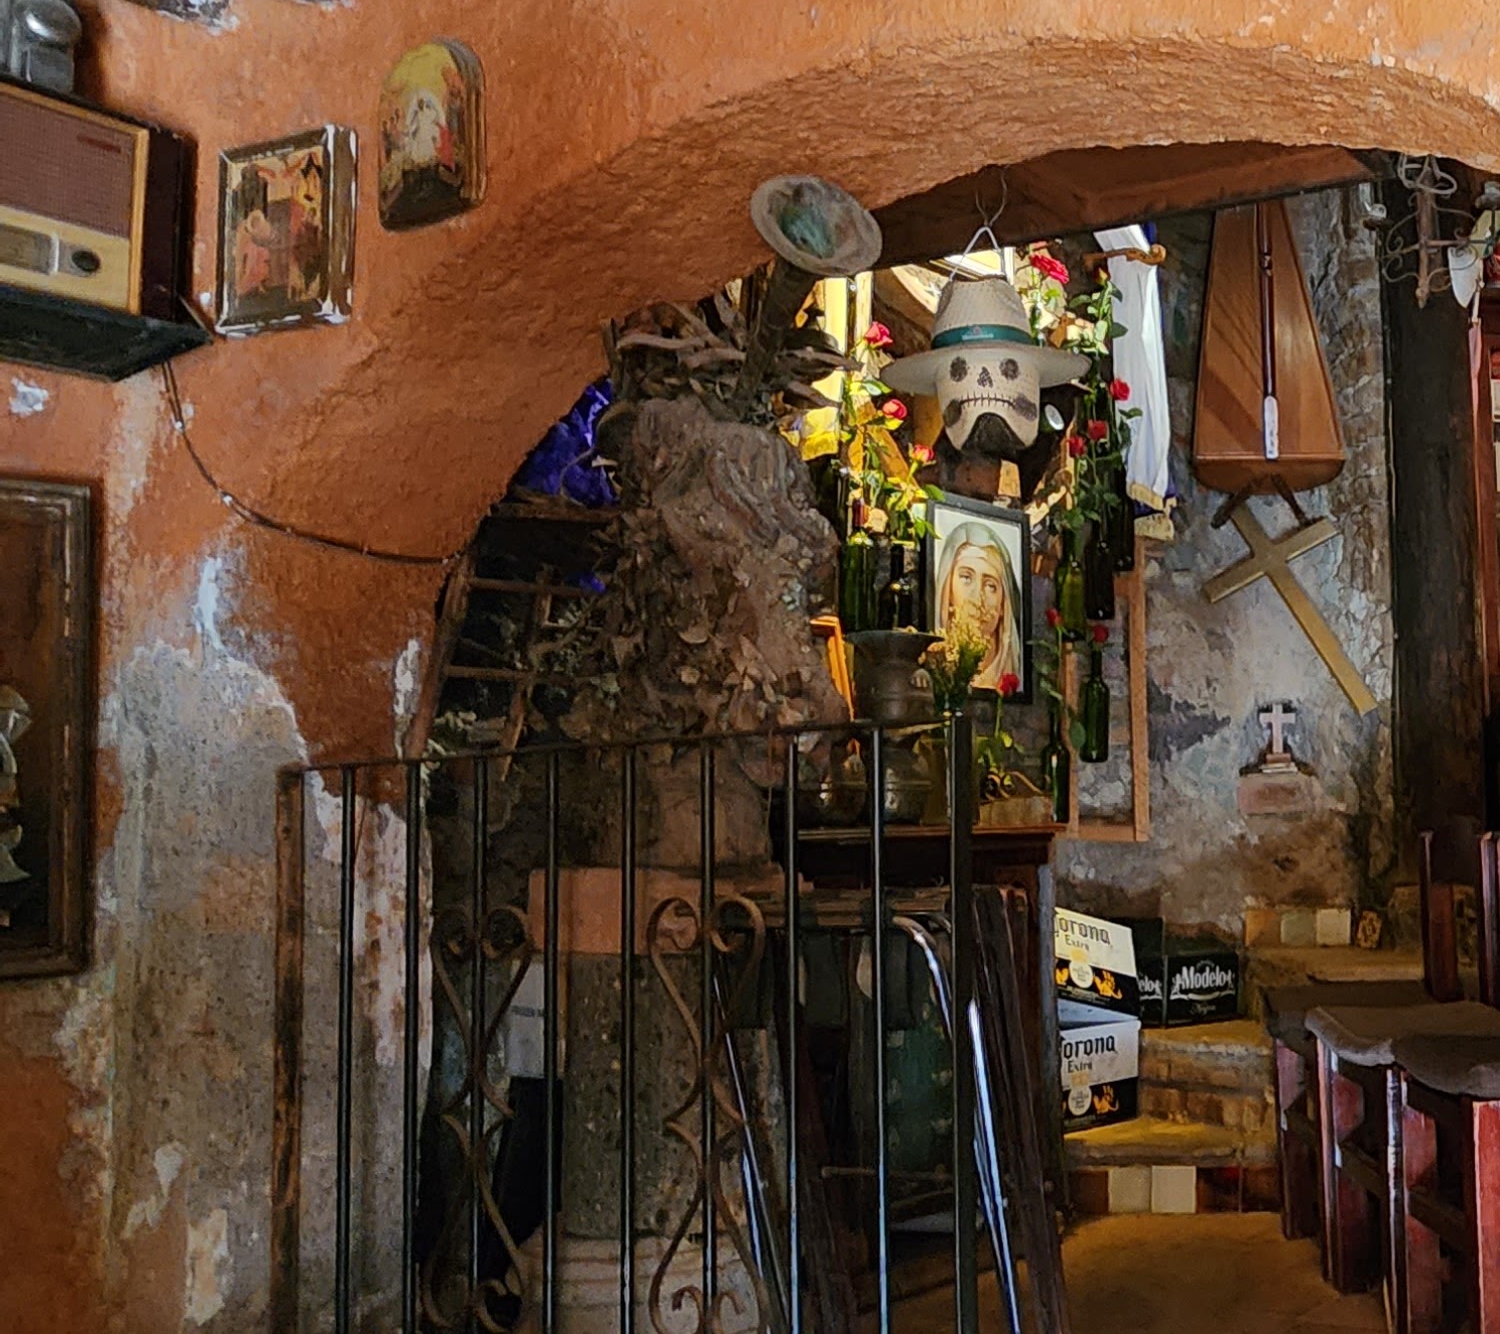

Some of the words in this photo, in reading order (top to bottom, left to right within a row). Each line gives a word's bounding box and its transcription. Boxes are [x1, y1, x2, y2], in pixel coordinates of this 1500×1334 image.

[1055, 917, 1111, 945] orona
[1065, 934, 1090, 952] Extra
[1179, 965, 1226, 990] Modelo
[1060, 1034, 1116, 1060] orona
[1067, 1060, 1093, 1074] Extra
